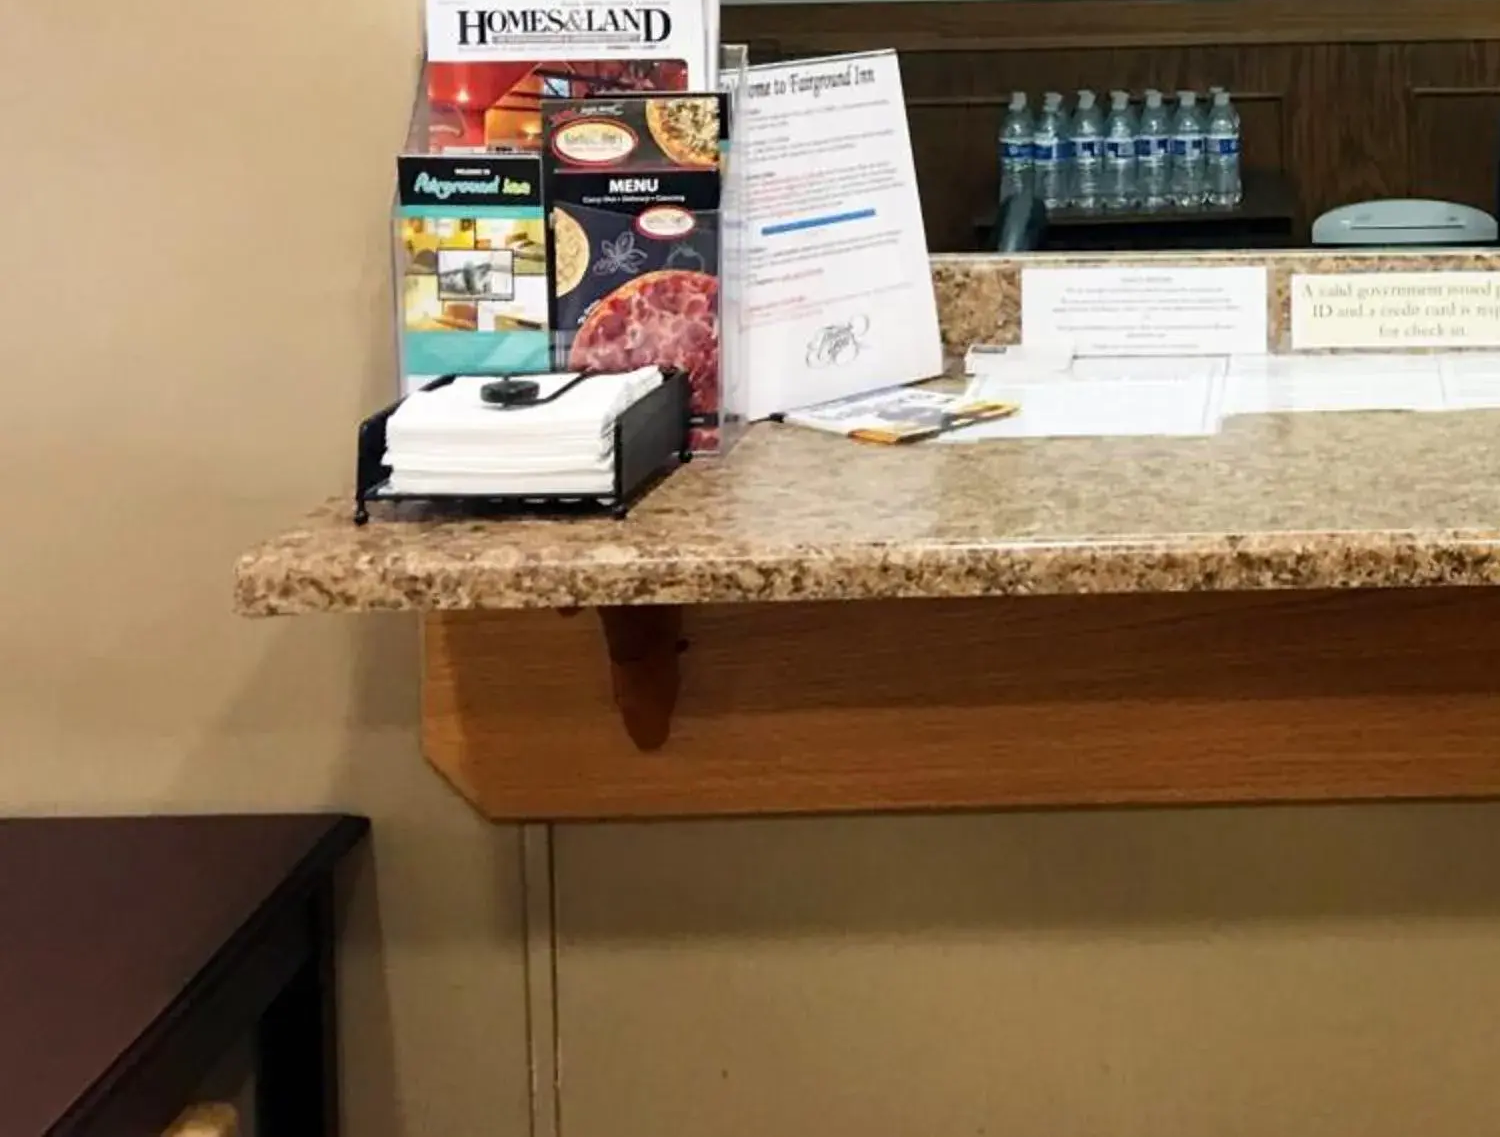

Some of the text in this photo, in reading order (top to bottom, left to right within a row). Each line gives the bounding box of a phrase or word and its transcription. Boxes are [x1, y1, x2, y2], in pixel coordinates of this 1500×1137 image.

[773, 79, 786, 96] to
[789, 64, 853, 99] Fairground
[855, 66, 876, 86] Inn
[608, 178, 660, 194] MENU
[1302, 284, 1313, 297] A
[1357, 285, 1443, 300] government
[1312, 304, 1333, 318] ID
[1338, 304, 1363, 318] and
[1380, 303, 1420, 317] credit
[1425, 302, 1455, 317] card
[1378, 324, 1399, 338] for
[1404, 323, 1444, 338] check
